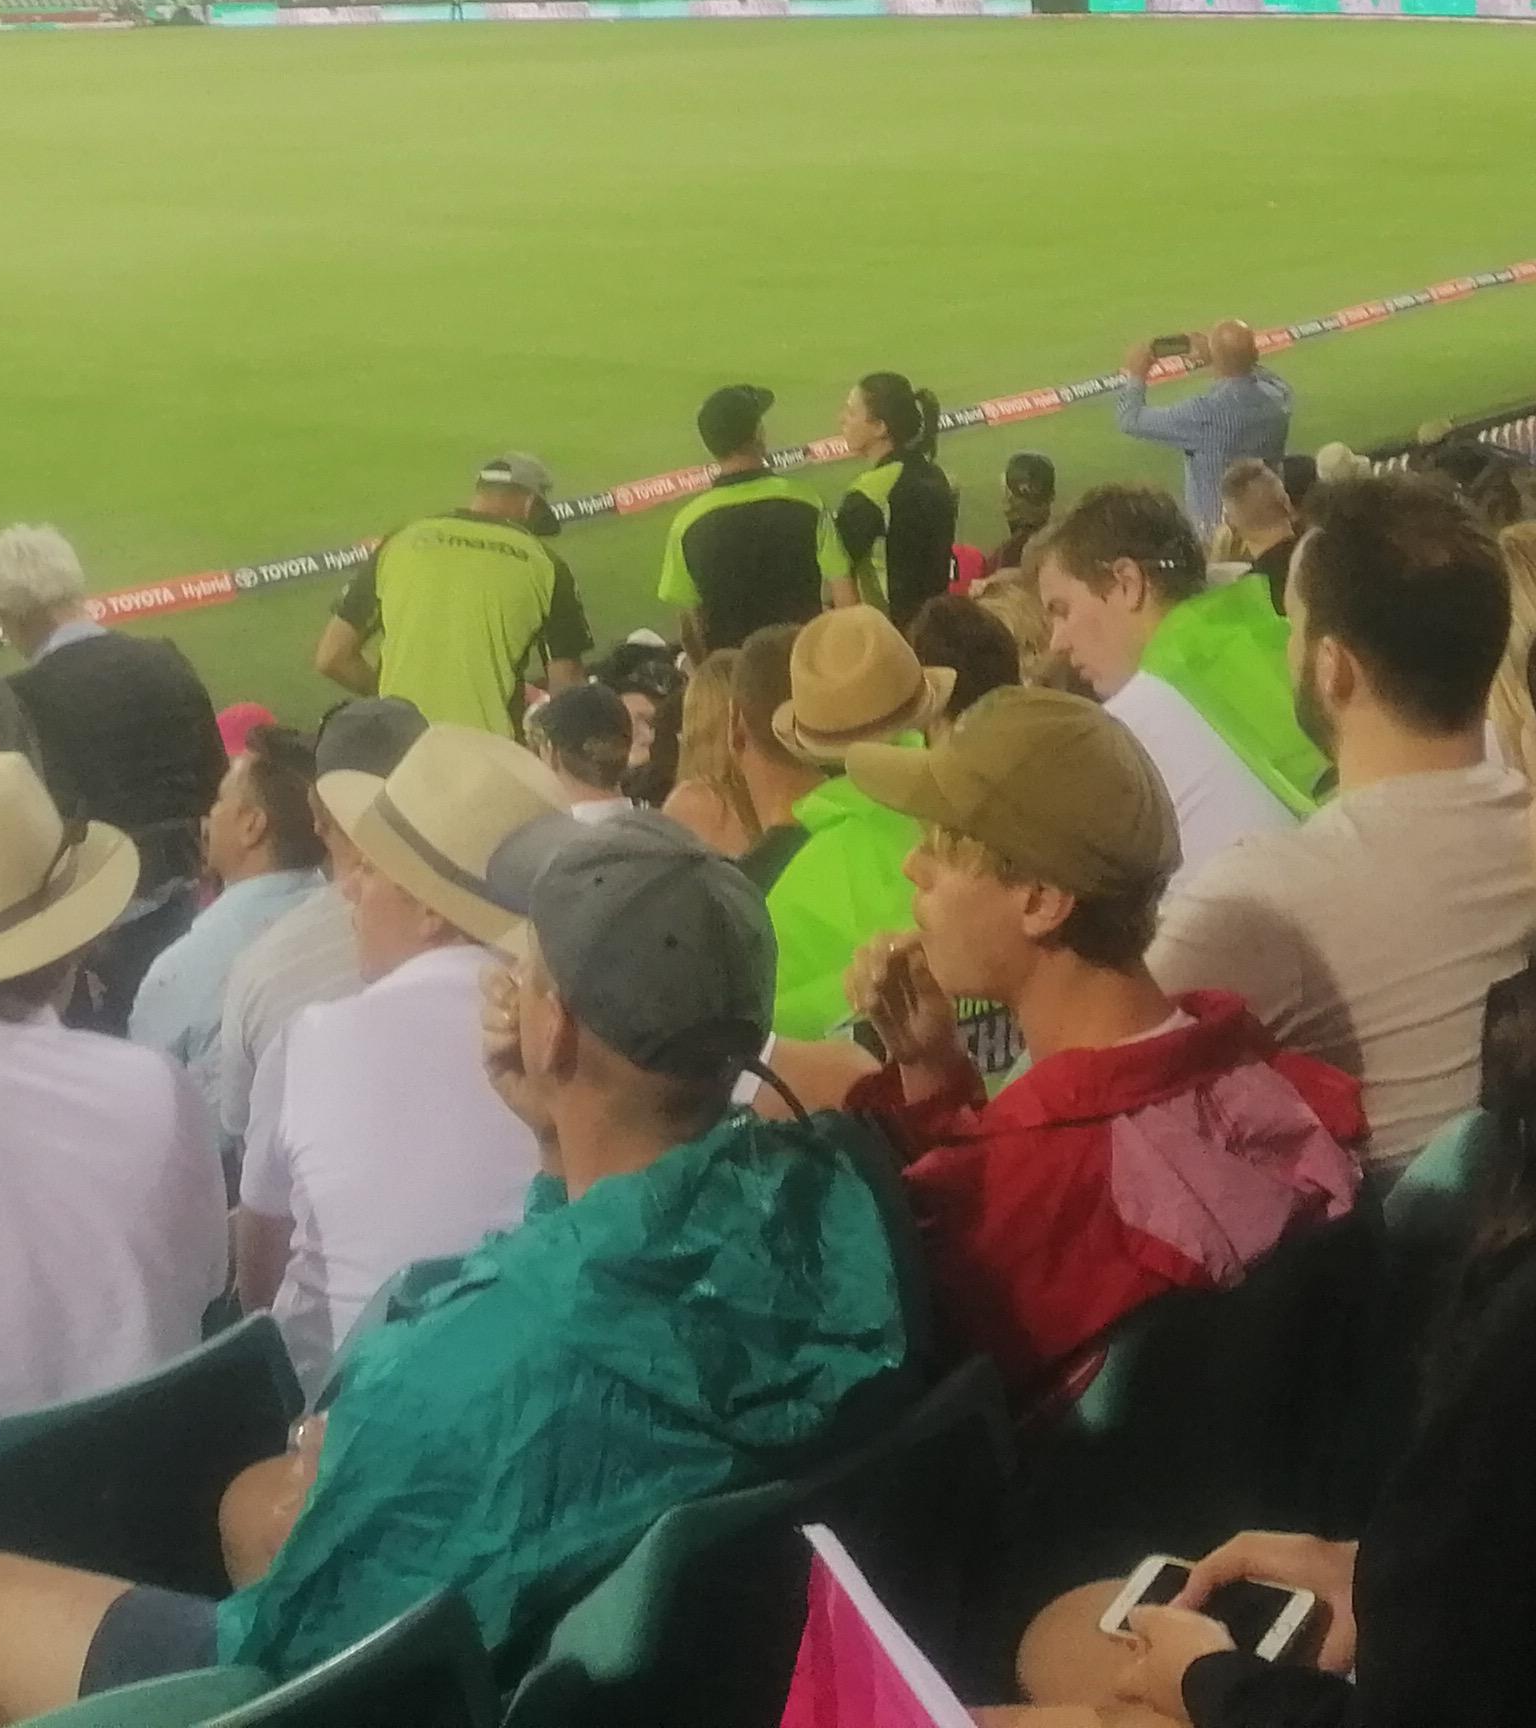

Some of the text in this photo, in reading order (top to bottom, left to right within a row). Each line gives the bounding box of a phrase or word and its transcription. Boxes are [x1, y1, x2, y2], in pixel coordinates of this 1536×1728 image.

[577, 492, 614, 516] Hybrid
[631, 479, 676, 502] TOYOTA
[257, 543, 369, 583] TOYOTA Hybrid
[107, 573, 232, 615] TOYOTA Hybrid
